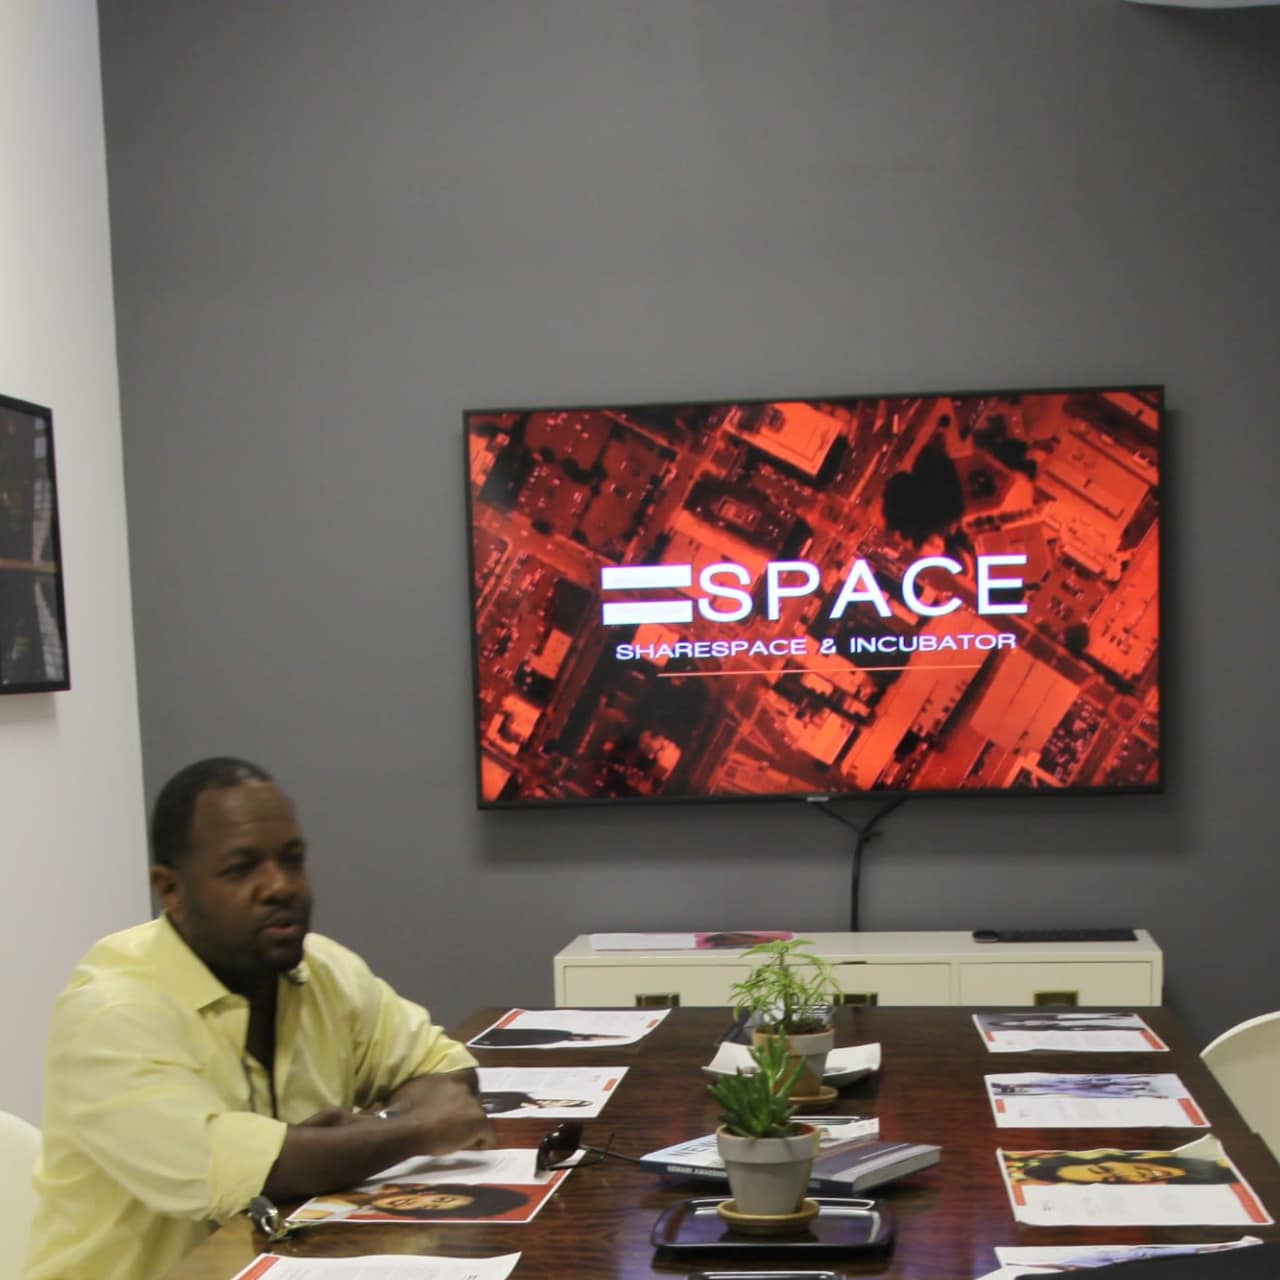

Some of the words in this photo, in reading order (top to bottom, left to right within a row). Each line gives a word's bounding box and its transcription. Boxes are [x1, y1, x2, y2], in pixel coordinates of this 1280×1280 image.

[615, 638, 807, 660] SHARESPACE
[820, 637, 837, 655] &
[850, 632, 1016, 655] INCUBATOR
